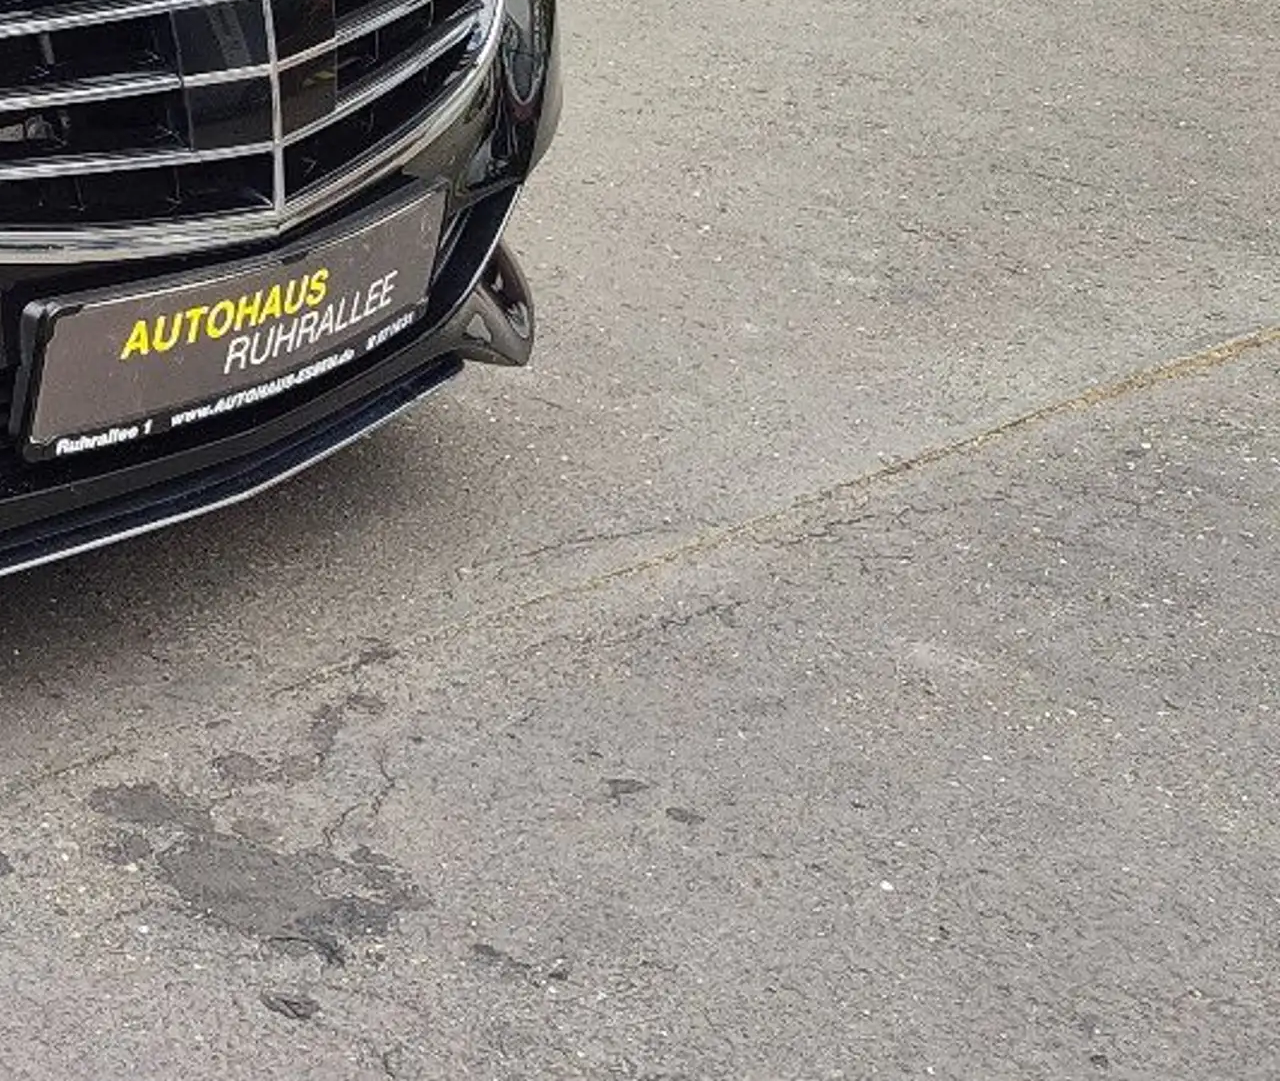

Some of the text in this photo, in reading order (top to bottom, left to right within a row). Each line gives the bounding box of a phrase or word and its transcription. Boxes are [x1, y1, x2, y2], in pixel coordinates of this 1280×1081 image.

[119, 268, 329, 359] AUTOHAUS
[224, 270, 398, 374] RUHRALLEE
[55, 425, 139, 456] Ruhrallee
[143, 419, 153, 435] 1
